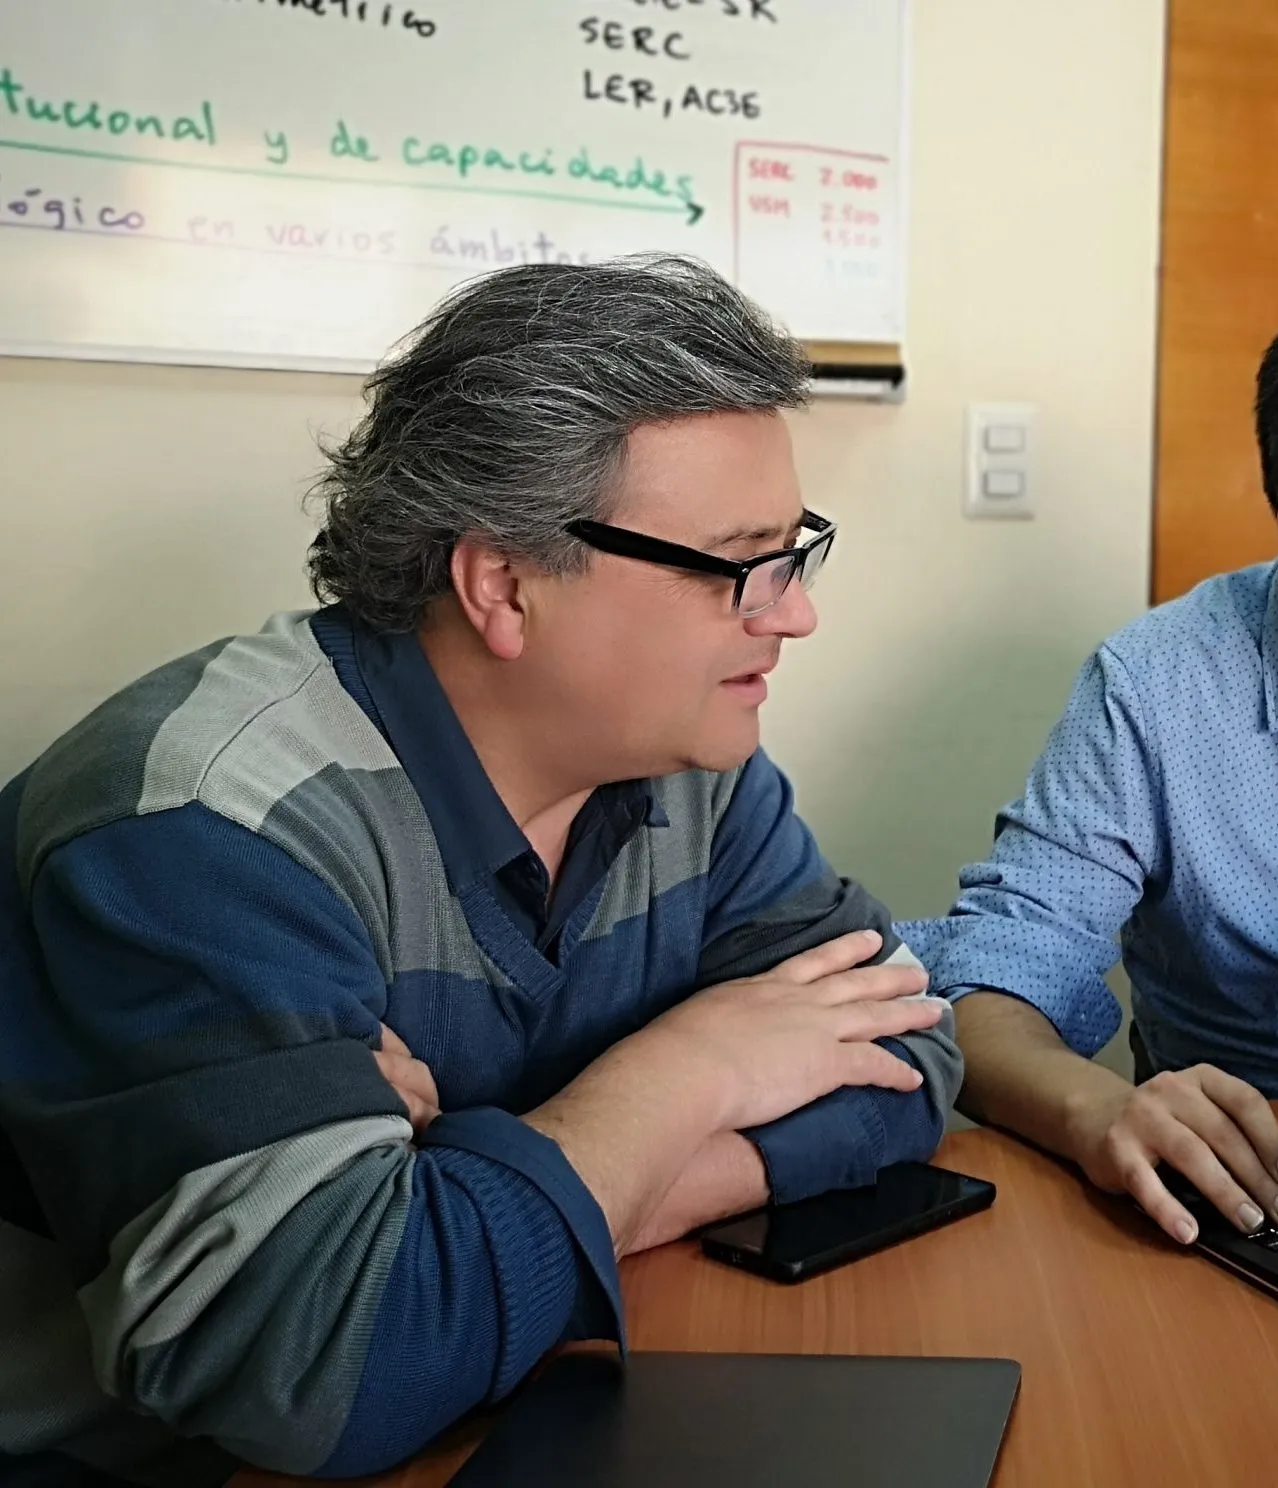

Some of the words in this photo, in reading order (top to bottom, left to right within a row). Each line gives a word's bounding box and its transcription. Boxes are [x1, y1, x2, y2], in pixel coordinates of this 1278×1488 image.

[579, 16, 691, 60] SERC
[265, 130, 289, 164] y
[330, 120, 380, 162] de
[402, 135, 696, 201] capacidades
[187, 215, 236, 245] en
[266, 221, 399, 256] varios
